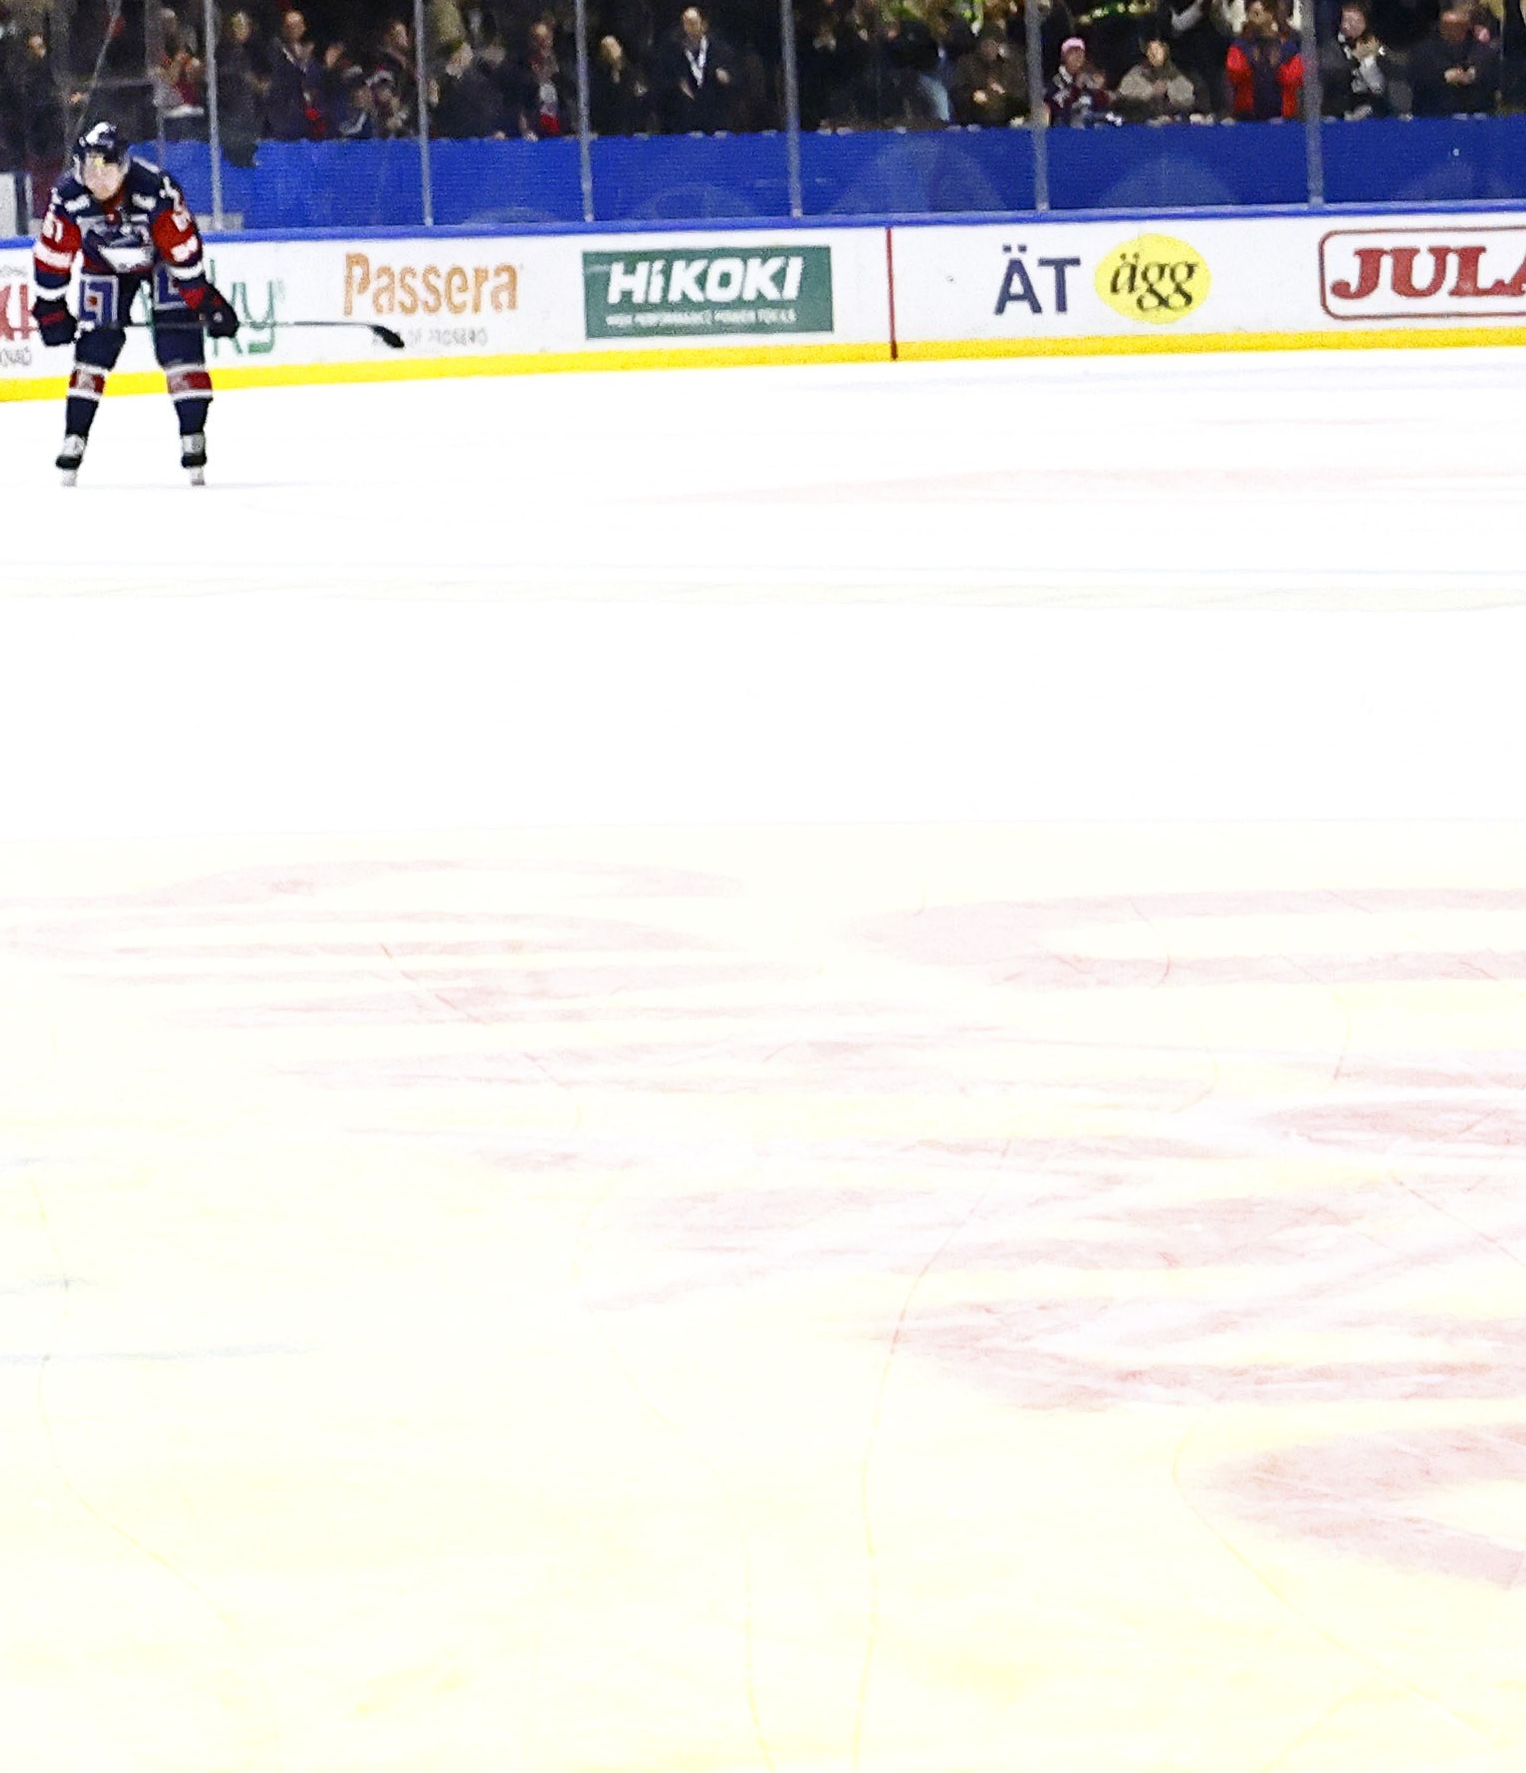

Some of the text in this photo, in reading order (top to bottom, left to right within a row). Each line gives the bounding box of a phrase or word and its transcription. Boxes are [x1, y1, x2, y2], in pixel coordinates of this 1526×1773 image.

[342, 251, 519, 318] Passera
[606, 256, 805, 306] HiKOKI
[994, 242, 1199, 316] ÄT ägg
